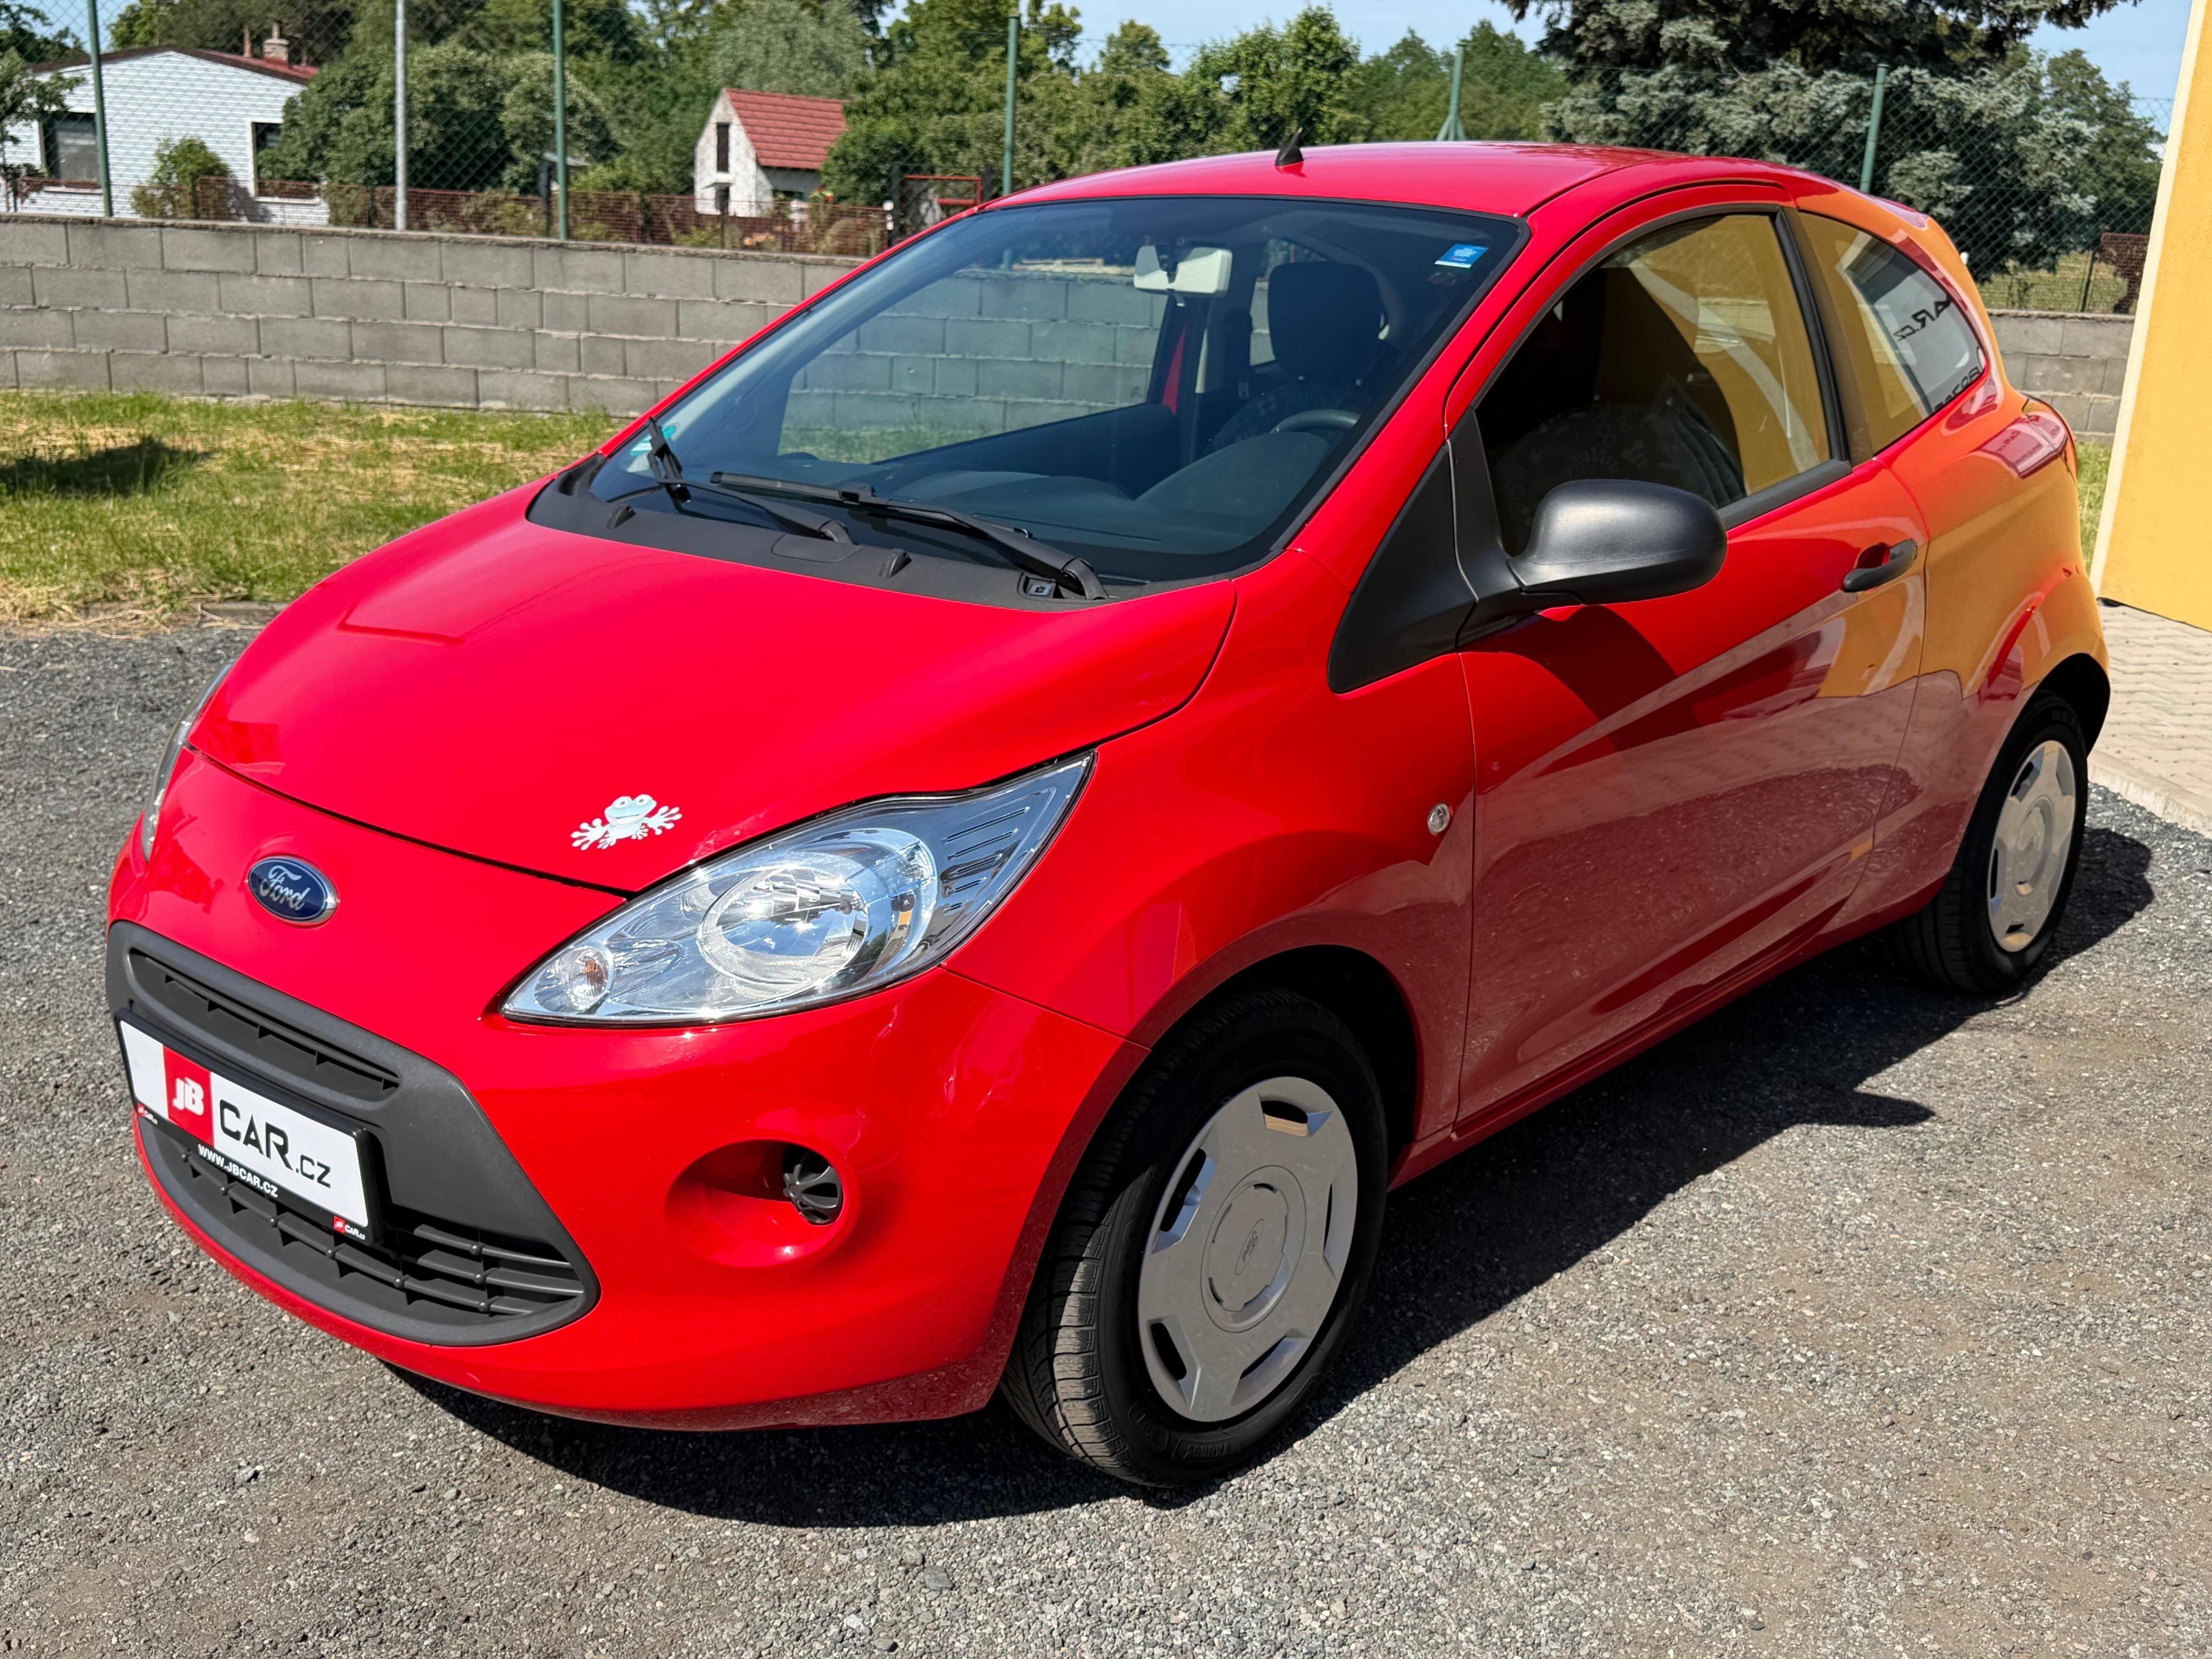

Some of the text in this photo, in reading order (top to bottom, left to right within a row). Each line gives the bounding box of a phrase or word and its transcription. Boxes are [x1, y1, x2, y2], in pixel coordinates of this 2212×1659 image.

[260, 865, 311, 911] Ford
[173, 1076, 204, 1116] JB
[198, 1143, 278, 1198] WWW.JBCAR.CZ
